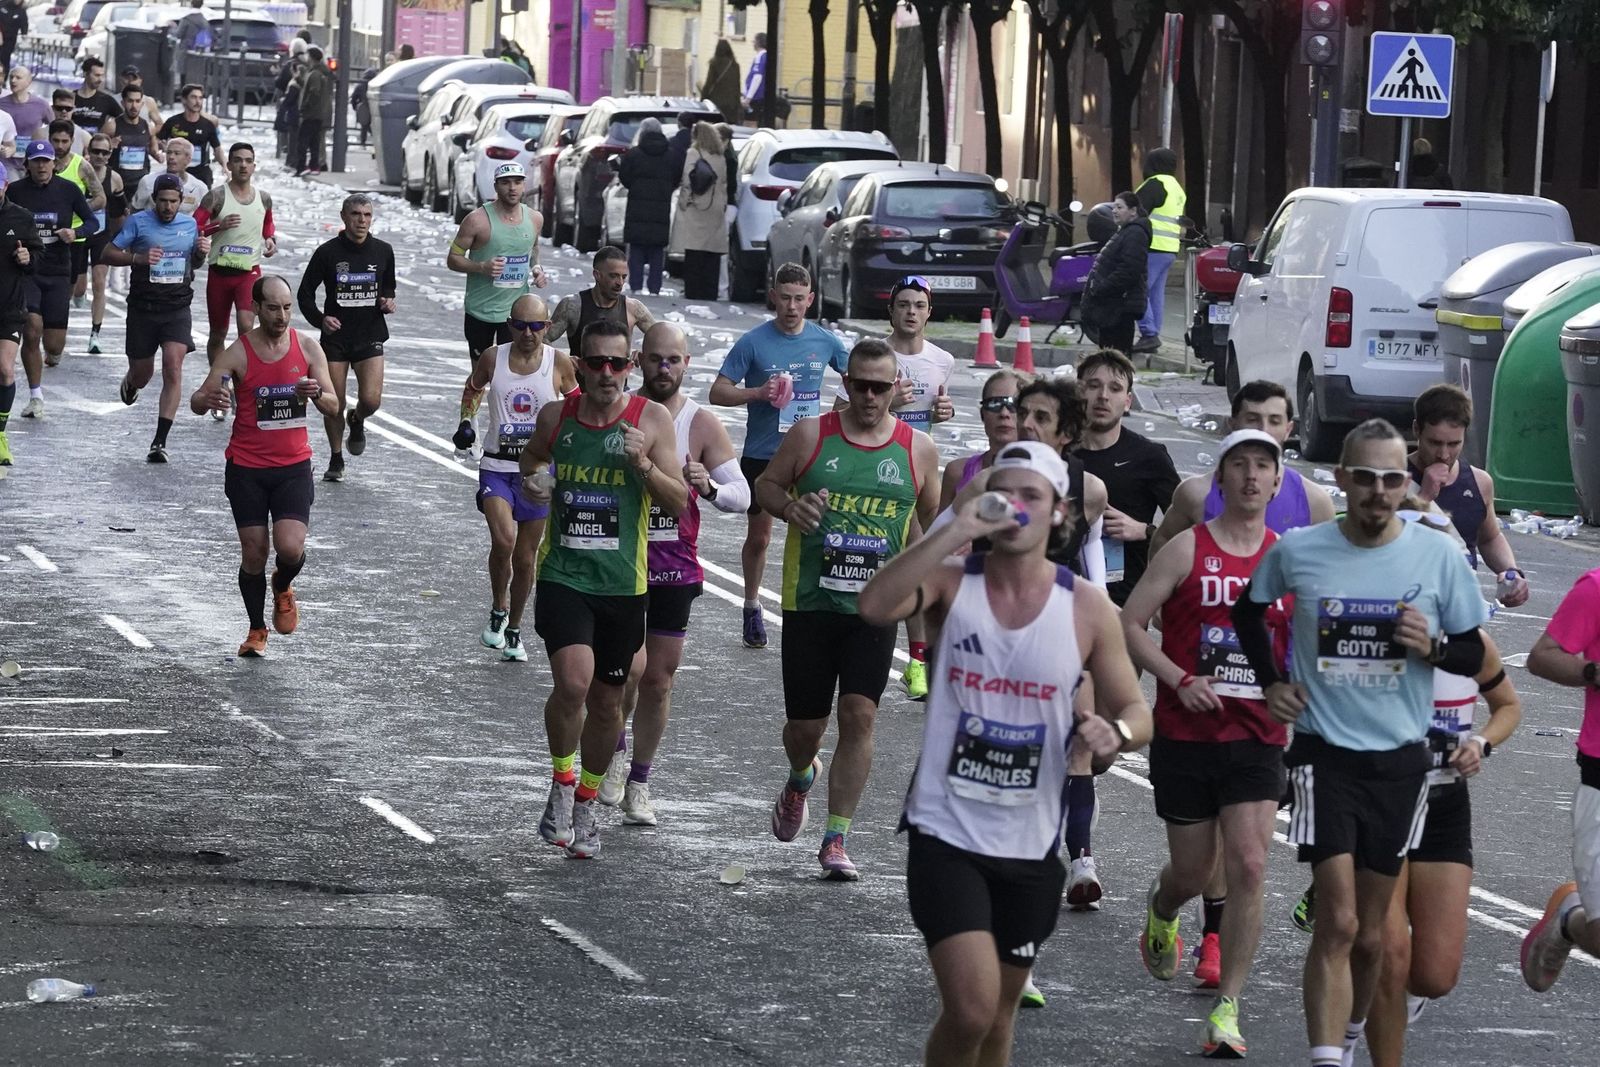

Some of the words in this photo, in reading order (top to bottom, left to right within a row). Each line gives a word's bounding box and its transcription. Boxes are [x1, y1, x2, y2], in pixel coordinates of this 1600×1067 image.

[953, 278, 974, 288] GBR
[1378, 342, 1410, 356] 9177
[1415, 344, 1439, 357] MFY
[272, 386, 296, 394] ZURIC
[272, 408, 292, 418] JAVI
[557, 464, 626, 486] BIKILA
[576, 495, 612, 504] ZURICH
[576, 512, 596, 520] 4891
[568, 522, 606, 536] ANGEL
[846, 538, 881, 548] ZURICH
[846, 554, 864, 564] 5299
[830, 564, 876, 580] ALVARO
[1348, 602, 1398, 614] ZURICH
[1350, 624, 1377, 637] 4160
[1336, 639, 1389, 657] GOTYF
[1214, 665, 1256, 684] CHRIS
[948, 666, 1057, 701] FRANCE
[988, 726, 1036, 740] ZURICH
[986, 750, 1014, 766] 4414
[956, 758, 1033, 787] CHARLES
